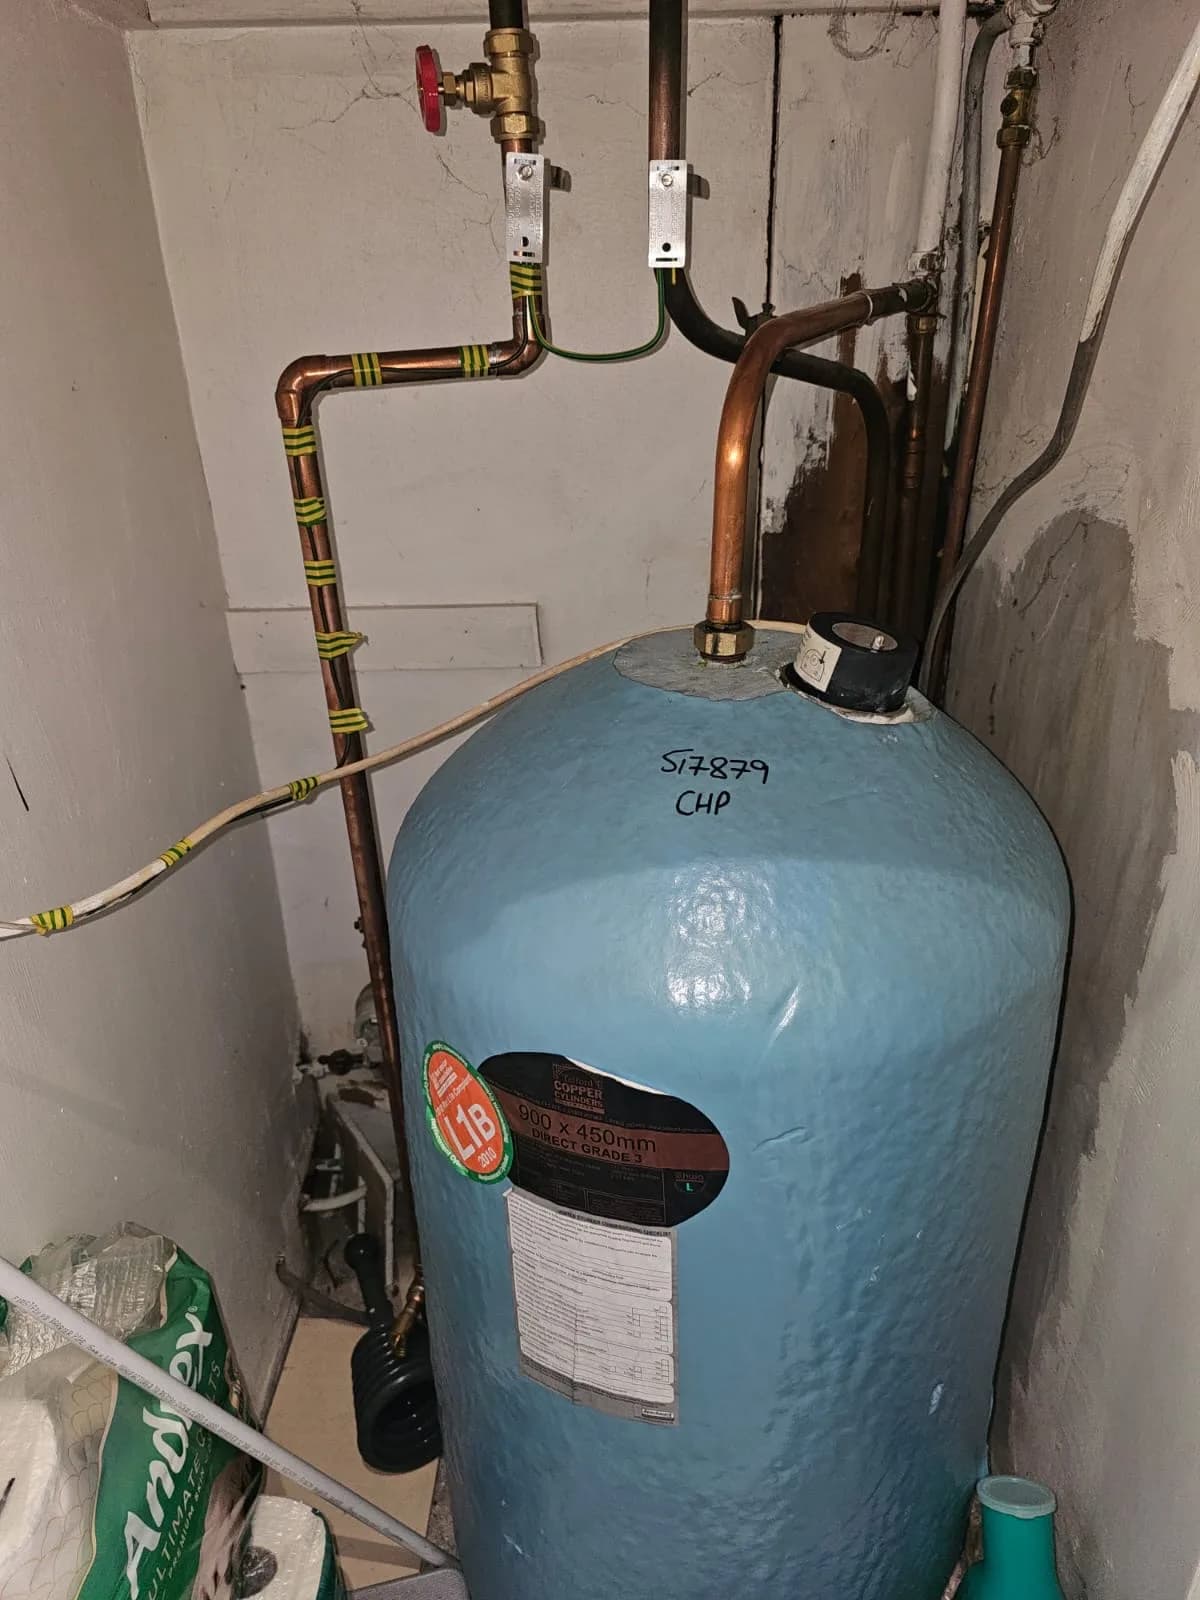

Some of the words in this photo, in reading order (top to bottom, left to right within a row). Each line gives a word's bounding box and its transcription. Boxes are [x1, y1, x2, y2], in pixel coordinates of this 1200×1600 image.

[676, 791, 731, 815] CHP
[553, 1080, 603, 1099] COPPER
[443, 1103, 496, 1161] L1B
[518, 1104, 552, 1130] 900
[576, 1124, 656, 1152] 450mm
[531, 1128, 578, 1150] DIRECT
[581, 1143, 630, 1162] GRADE
[634, 1154, 643, 1163] 3
[477, 1146, 497, 1169] 2010
[149, 1452, 200, 1600] ULTIMATE
